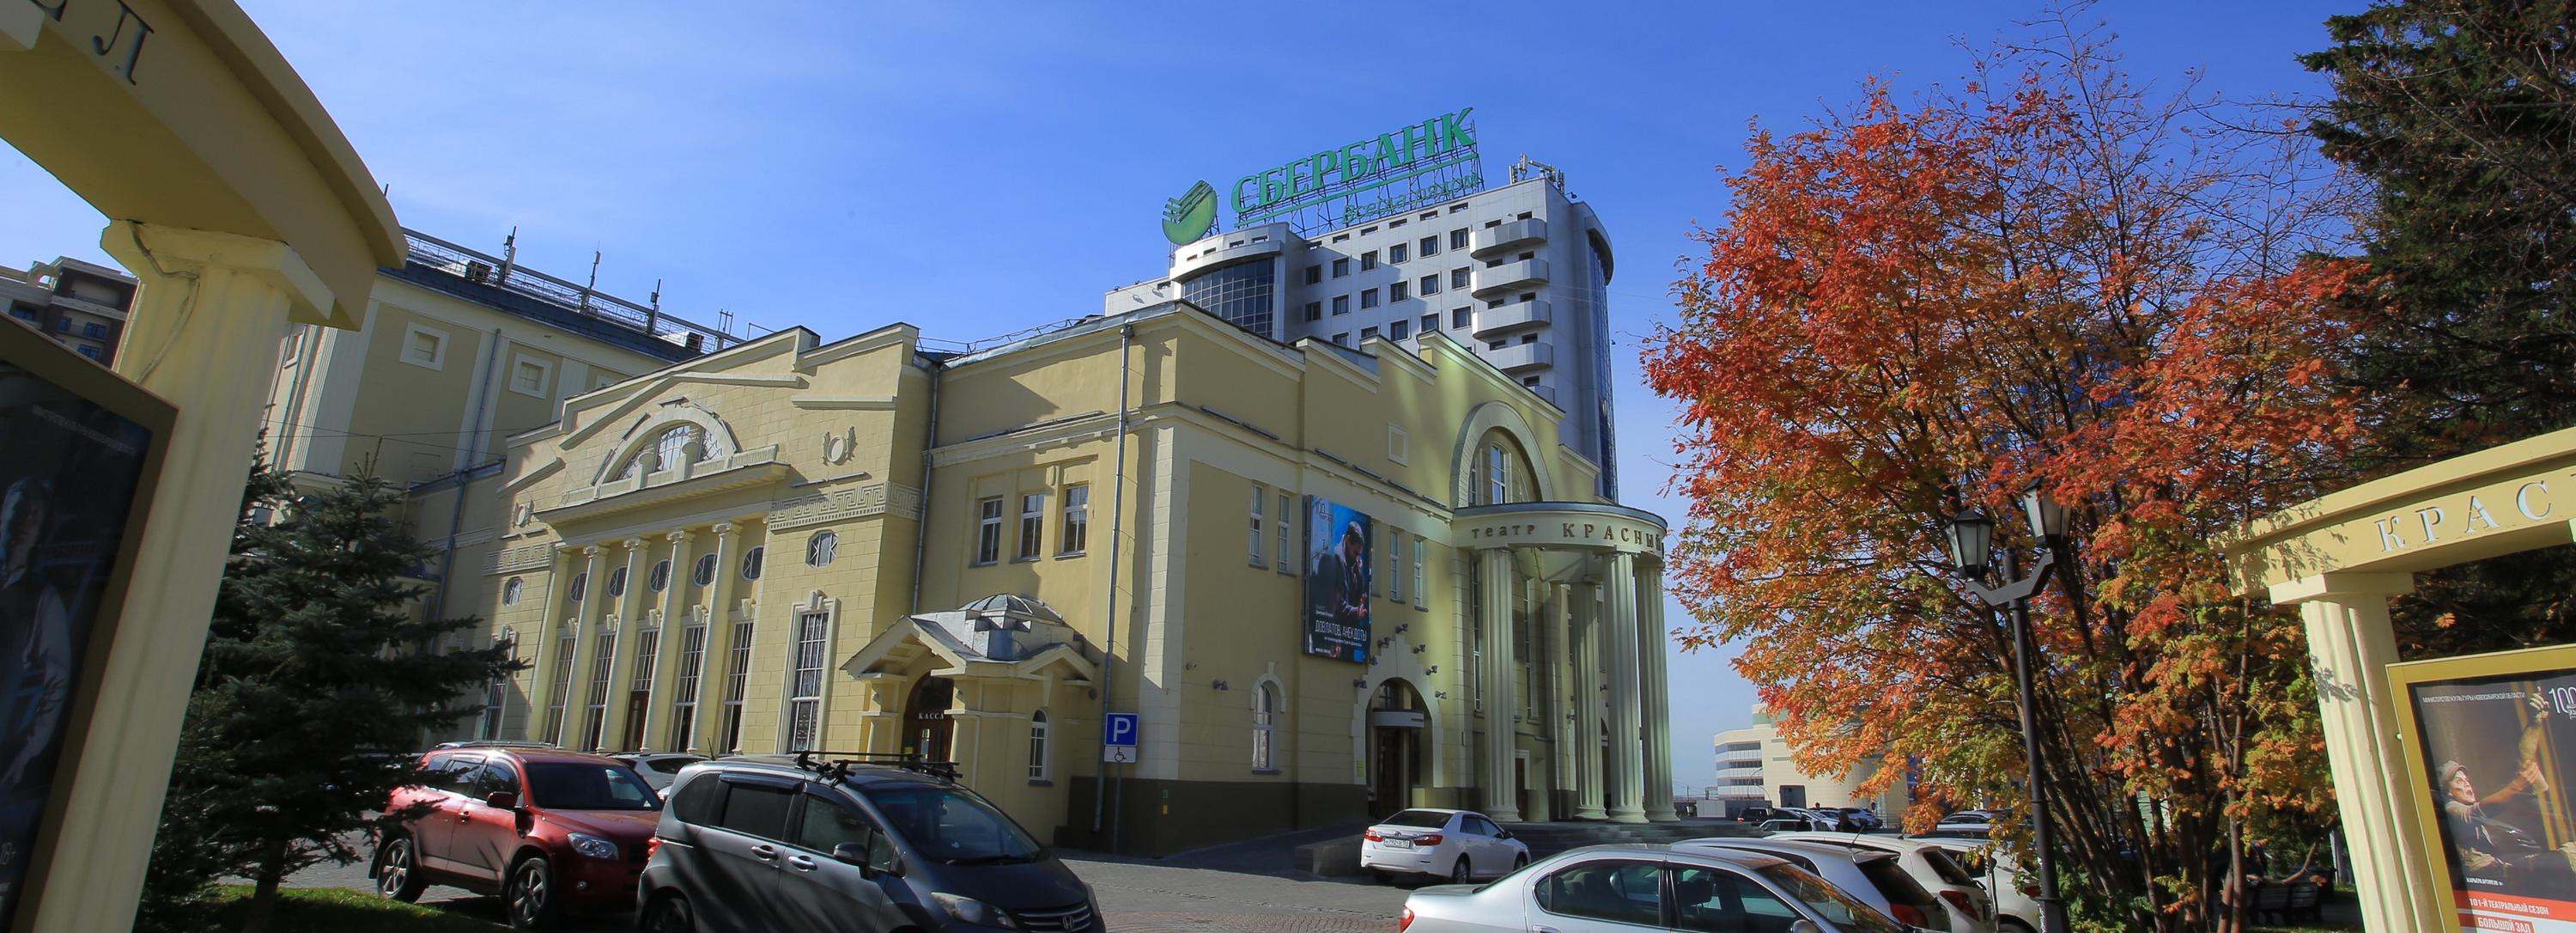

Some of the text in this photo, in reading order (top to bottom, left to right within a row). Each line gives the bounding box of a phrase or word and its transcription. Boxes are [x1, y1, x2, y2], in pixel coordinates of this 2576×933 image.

[1230, 107, 1474, 214] СБЕРБАНК
[2374, 473, 2576, 552] КРАС
[1562, 522, 1662, 552] КРАСНЫЙ
[1113, 717, 1131, 742] P
[2488, 900, 2529, 913] ТЕАТРАЛЬНЫЙ
[2529, 906, 2549, 916] СЕЗОН
[2477, 917, 2531, 933] БОЛЬШОЙ ЗАЛ
